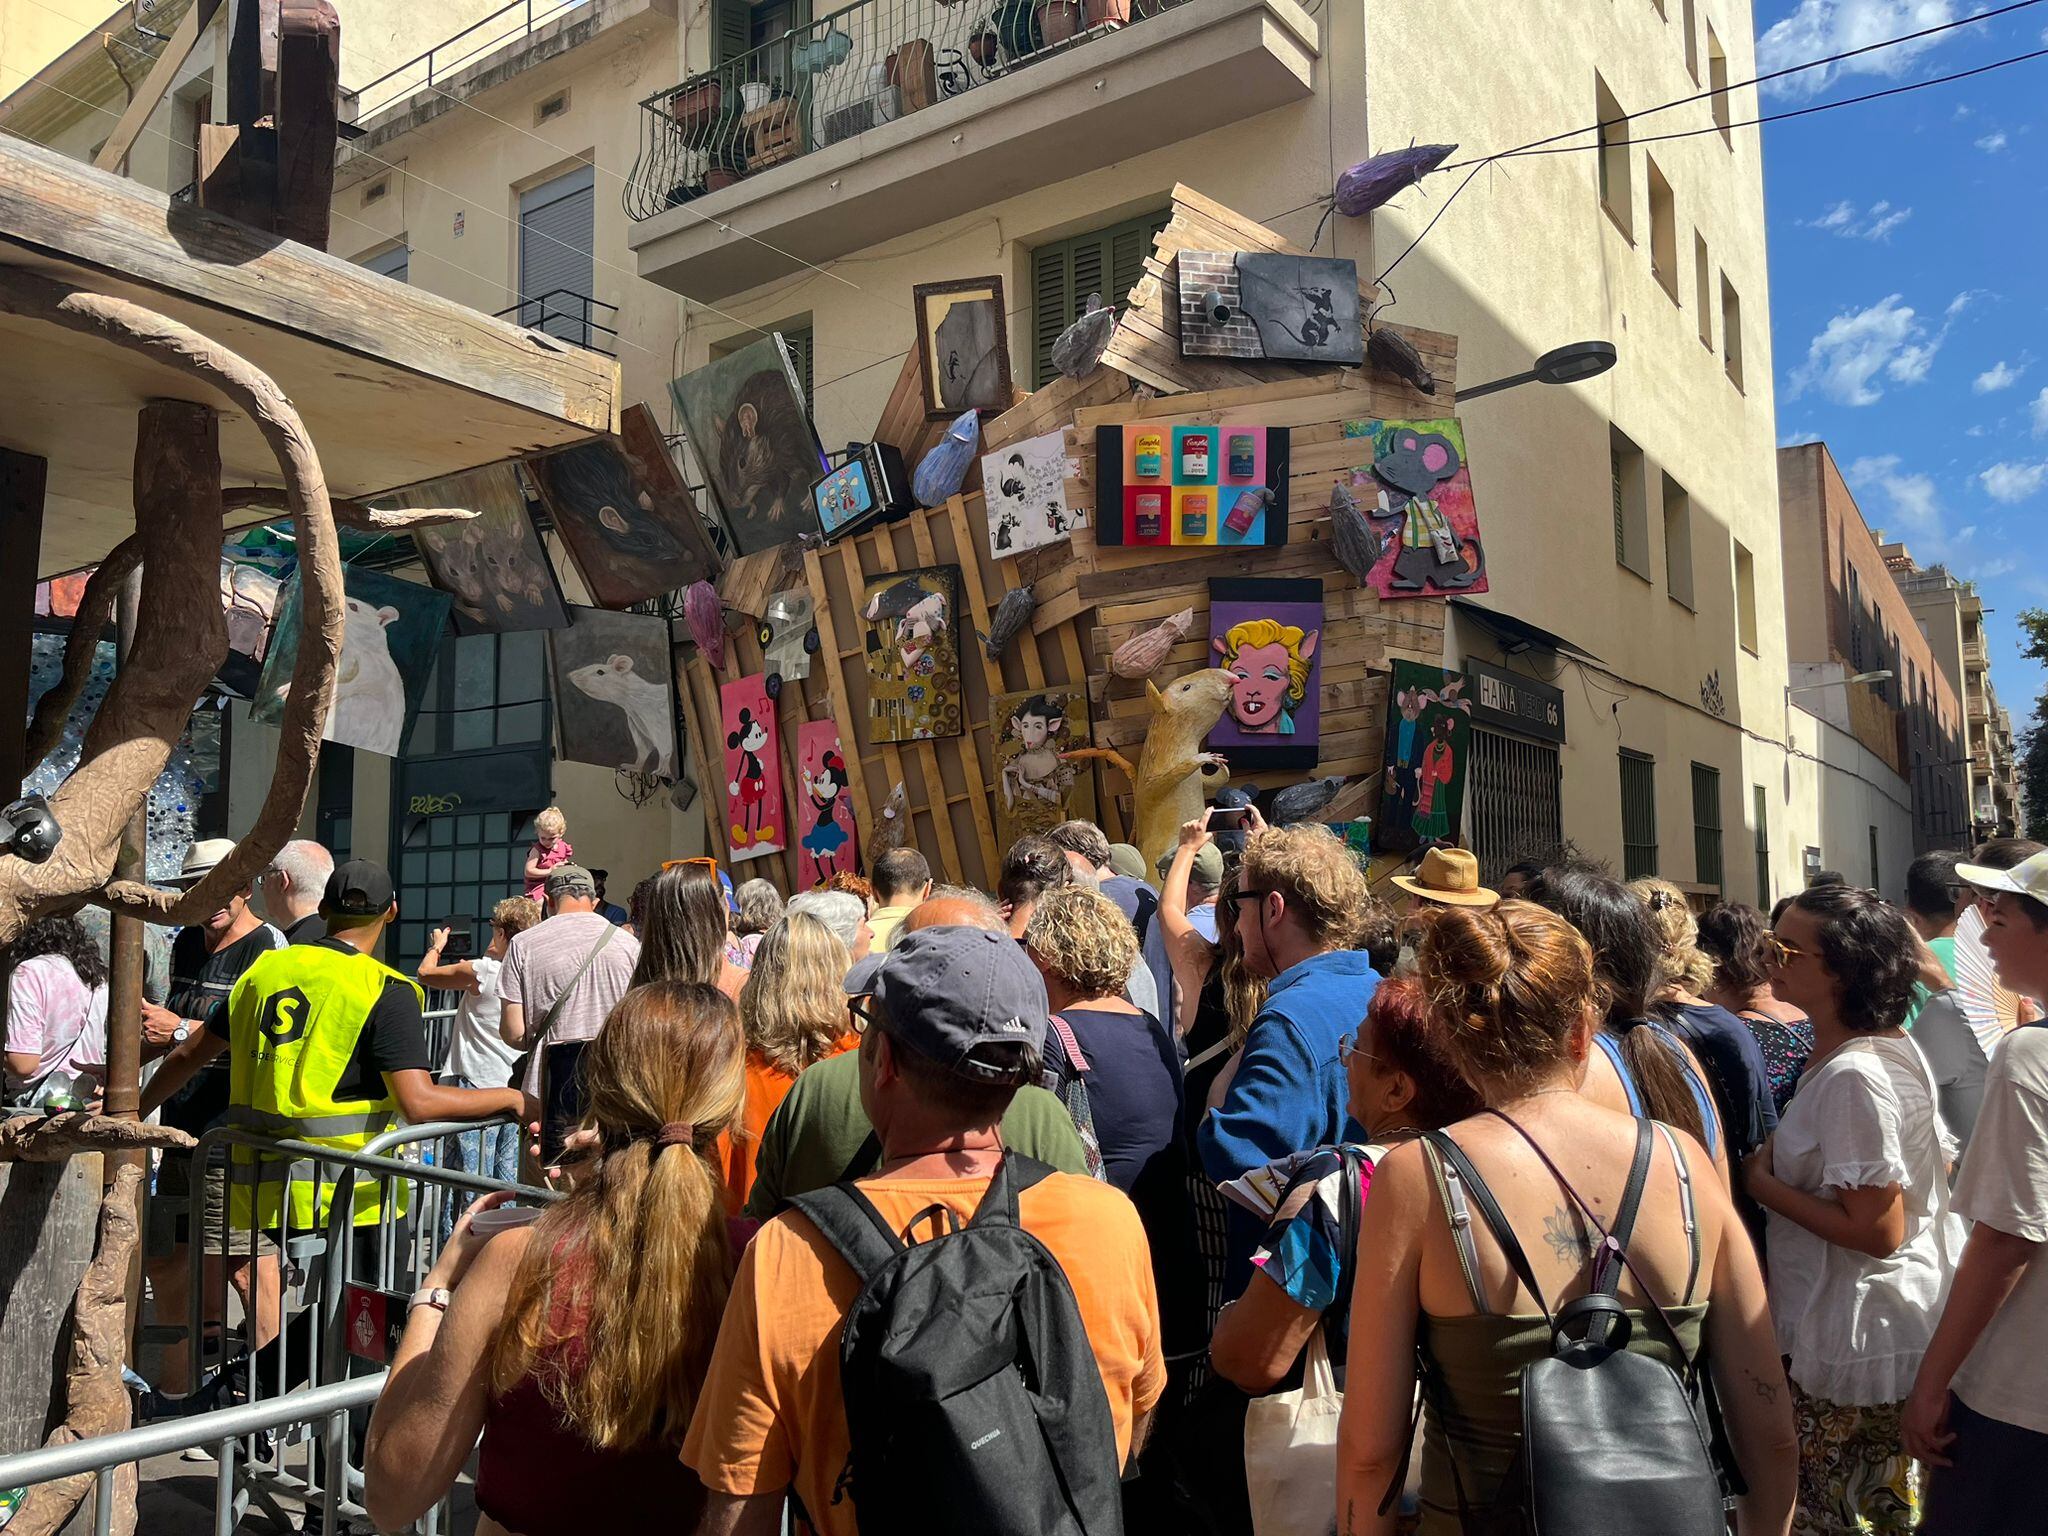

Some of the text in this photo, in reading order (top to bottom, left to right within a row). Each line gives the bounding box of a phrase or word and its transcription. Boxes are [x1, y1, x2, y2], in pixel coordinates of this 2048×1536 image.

[1481, 676, 1516, 713] HANA
[1546, 702, 1558, 727] 66
[270, 997, 300, 1035] S
[971, 1428, 1000, 1450] QUECHUA
